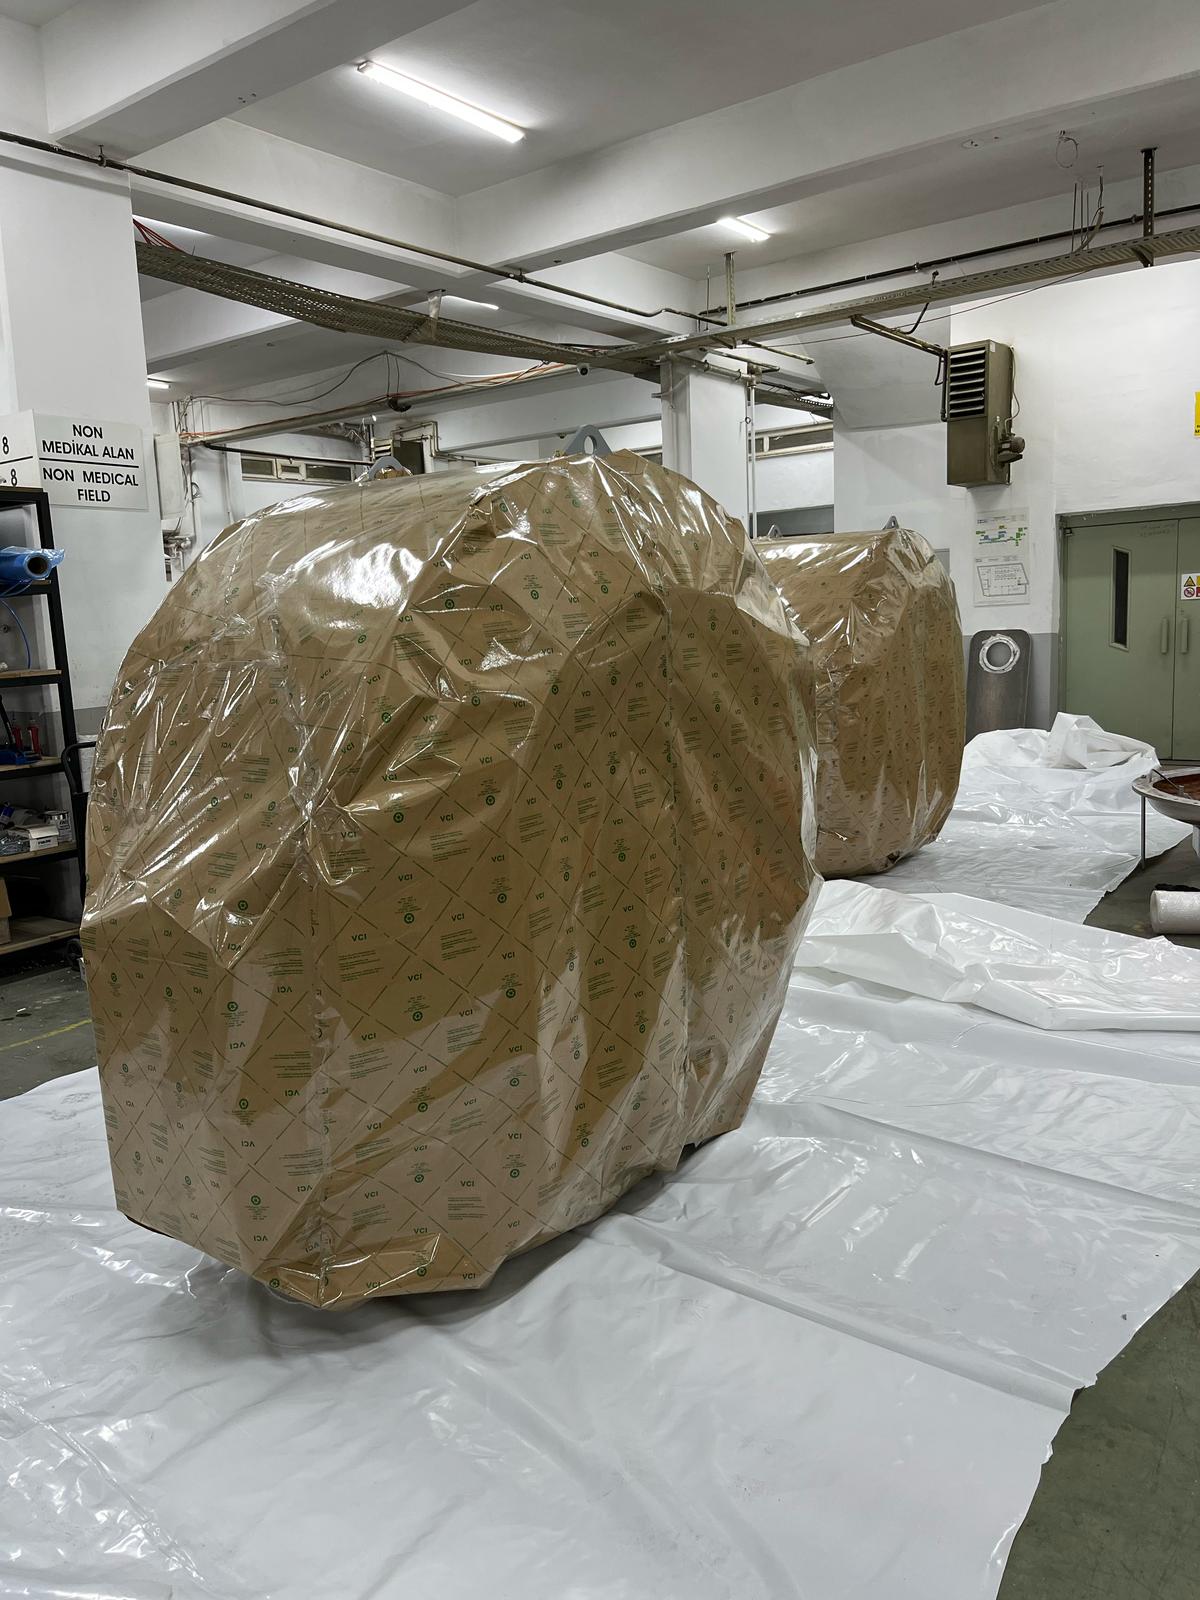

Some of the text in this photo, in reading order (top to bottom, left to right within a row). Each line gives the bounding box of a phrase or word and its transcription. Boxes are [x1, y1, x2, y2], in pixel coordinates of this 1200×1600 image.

[72, 424, 103, 439] NON
[2, 436, 9, 454] 8
[42, 440, 134, 460] MEDİKAL ALAN
[10, 468, 17, 486] 8
[42, 467, 139, 486] NON MEDICAL
[77, 489, 111, 502] FIELD
[320, 669, 332, 679] VCI
[366, 675, 381, 684] VCI
[341, 743, 355, 753] VCI
[440, 814, 454, 822] VCI
[452, 913, 465, 921] VCI
[459, 1009, 472, 1017] VCI
[361, 1033, 376, 1041] VCI
